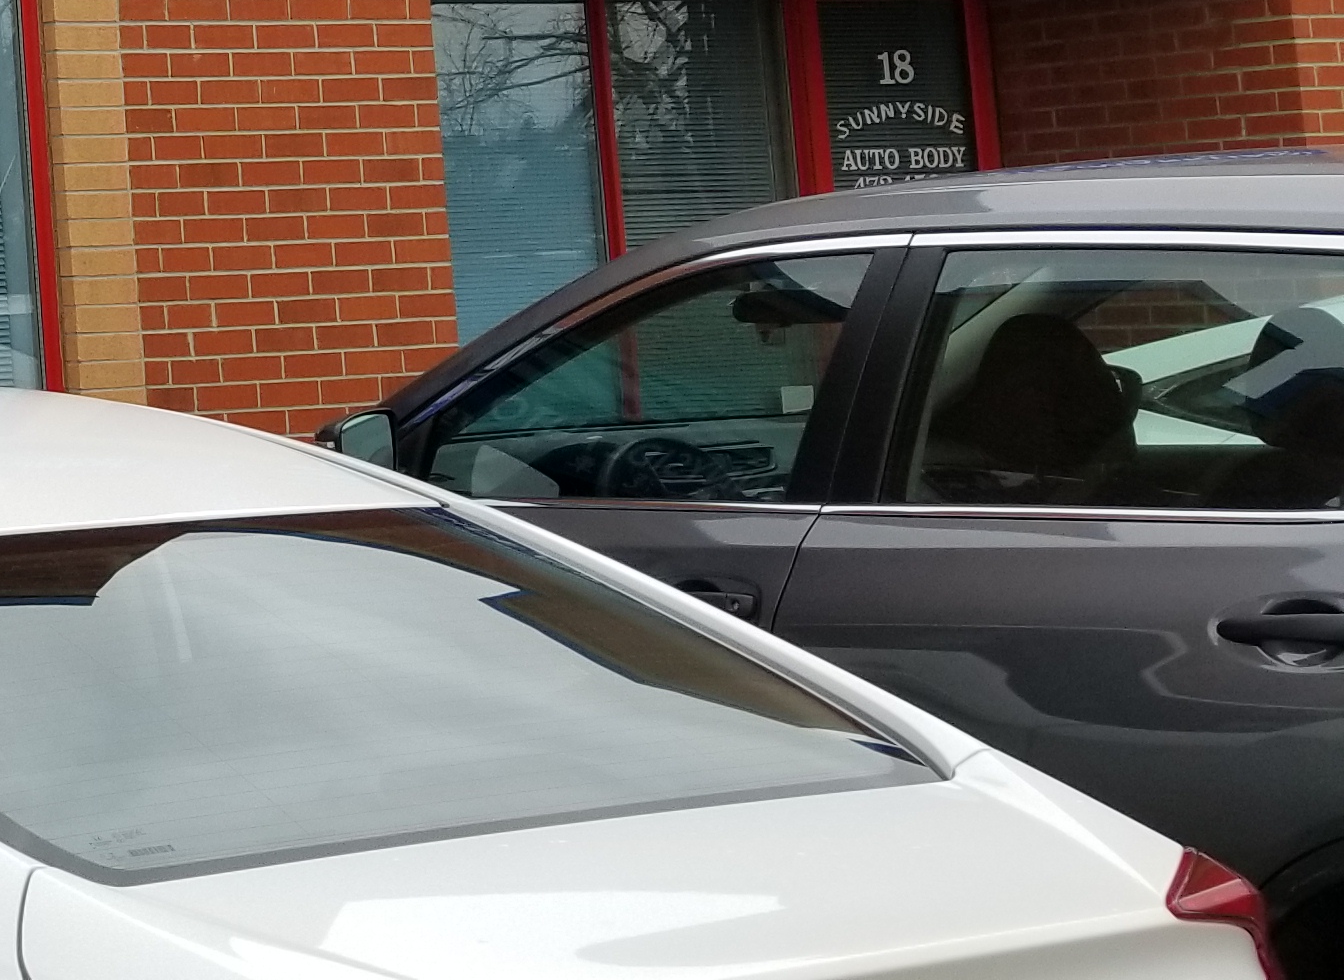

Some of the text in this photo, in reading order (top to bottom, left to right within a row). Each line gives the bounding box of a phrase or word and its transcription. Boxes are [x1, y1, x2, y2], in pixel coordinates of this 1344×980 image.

[877, 49, 915, 85] 18
[836, 101, 966, 140] SUNNYSIDE
[841, 146, 966, 171] AUTO BODY
